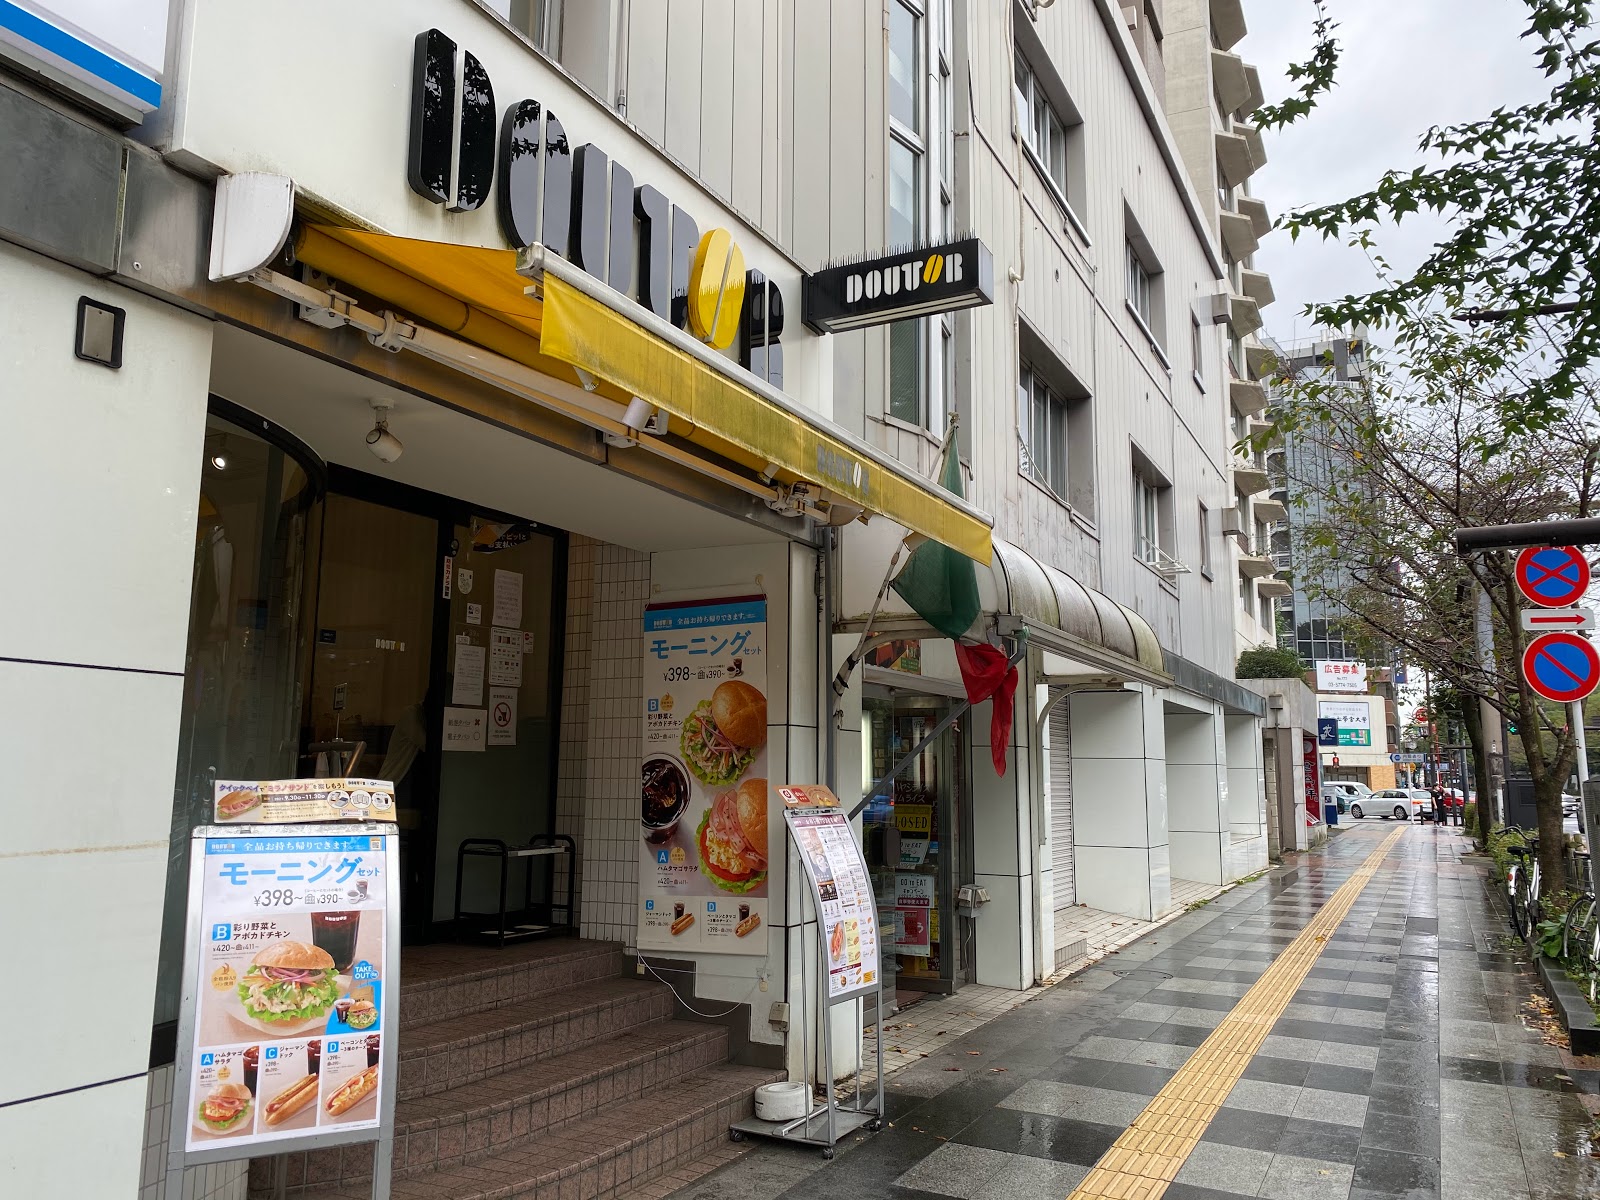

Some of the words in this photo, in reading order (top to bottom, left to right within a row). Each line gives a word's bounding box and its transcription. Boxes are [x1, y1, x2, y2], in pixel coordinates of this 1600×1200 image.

[408, 28, 784, 391] DOUTOR
[846, 253, 963, 304] DOUTOR
[816, 443, 870, 497] DOUTOR
[650, 630, 752, 659] モーニング
[743, 646, 762, 655] セット
[650, 699, 657, 711] B
[659, 852, 667, 863] A
[219, 856, 363, 885] モーニング
[356, 866, 380, 877] セット
[916, 878, 927, 886] EAT
[647, 901, 653, 909] C
[708, 903, 715, 911] D
[232, 922, 277, 932] 彩り野菜と
[216, 925, 227, 940] B
[232, 930, 291, 941] アボカドチキン
[354, 965, 373, 973] TAKE
[330, 1043, 337, 1051] D
[214, 1050, 244, 1058] ハムタマゴ
[268, 1048, 275, 1058] C
[279, 1051, 294, 1059] ドック
[203, 1055, 211, 1064] A
[214, 1057, 232, 1065] サラダ
